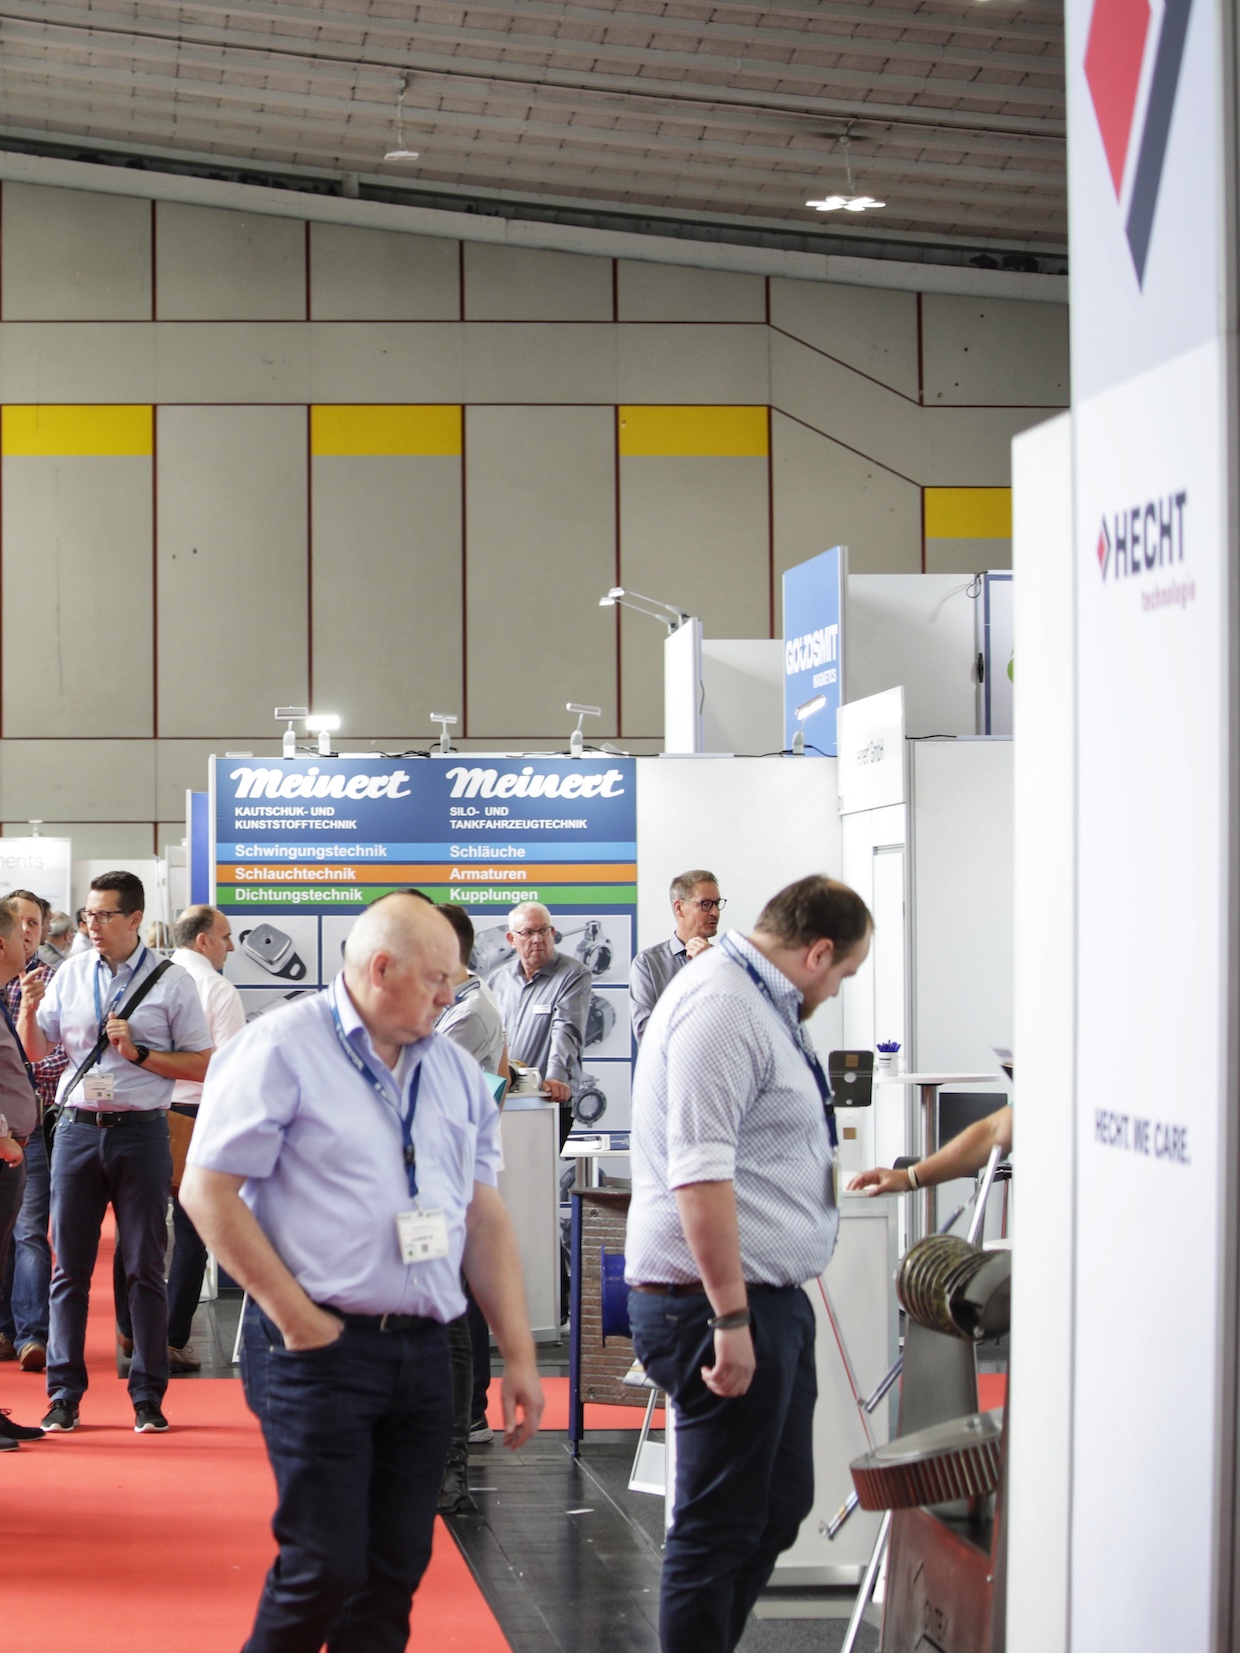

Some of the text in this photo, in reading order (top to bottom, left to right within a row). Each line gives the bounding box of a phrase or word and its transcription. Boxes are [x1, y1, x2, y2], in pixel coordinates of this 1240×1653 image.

[1114, 489, 1186, 580] HECHT
[229, 766, 412, 800] Meinert
[445, 766, 625, 799] Meinert
[234, 807, 336, 817] KAUTSCHUK- UND
[449, 806, 510, 817] SILO- UND
[234, 819, 358, 830] KUNSTSTOFFTECHNIK
[449, 819, 588, 830] TANKFAHRZEUGTECHNIK
[234, 844, 388, 860] Schwingungstechnik
[449, 845, 526, 858] Schläuche
[234, 867, 357, 880] Schlauchtechnik
[449, 867, 527, 880] Armaturen
[234, 888, 363, 904] Dichtungstechnik
[449, 888, 539, 904] Kupplungen
[1154, 1121, 1192, 1166] CARE.
